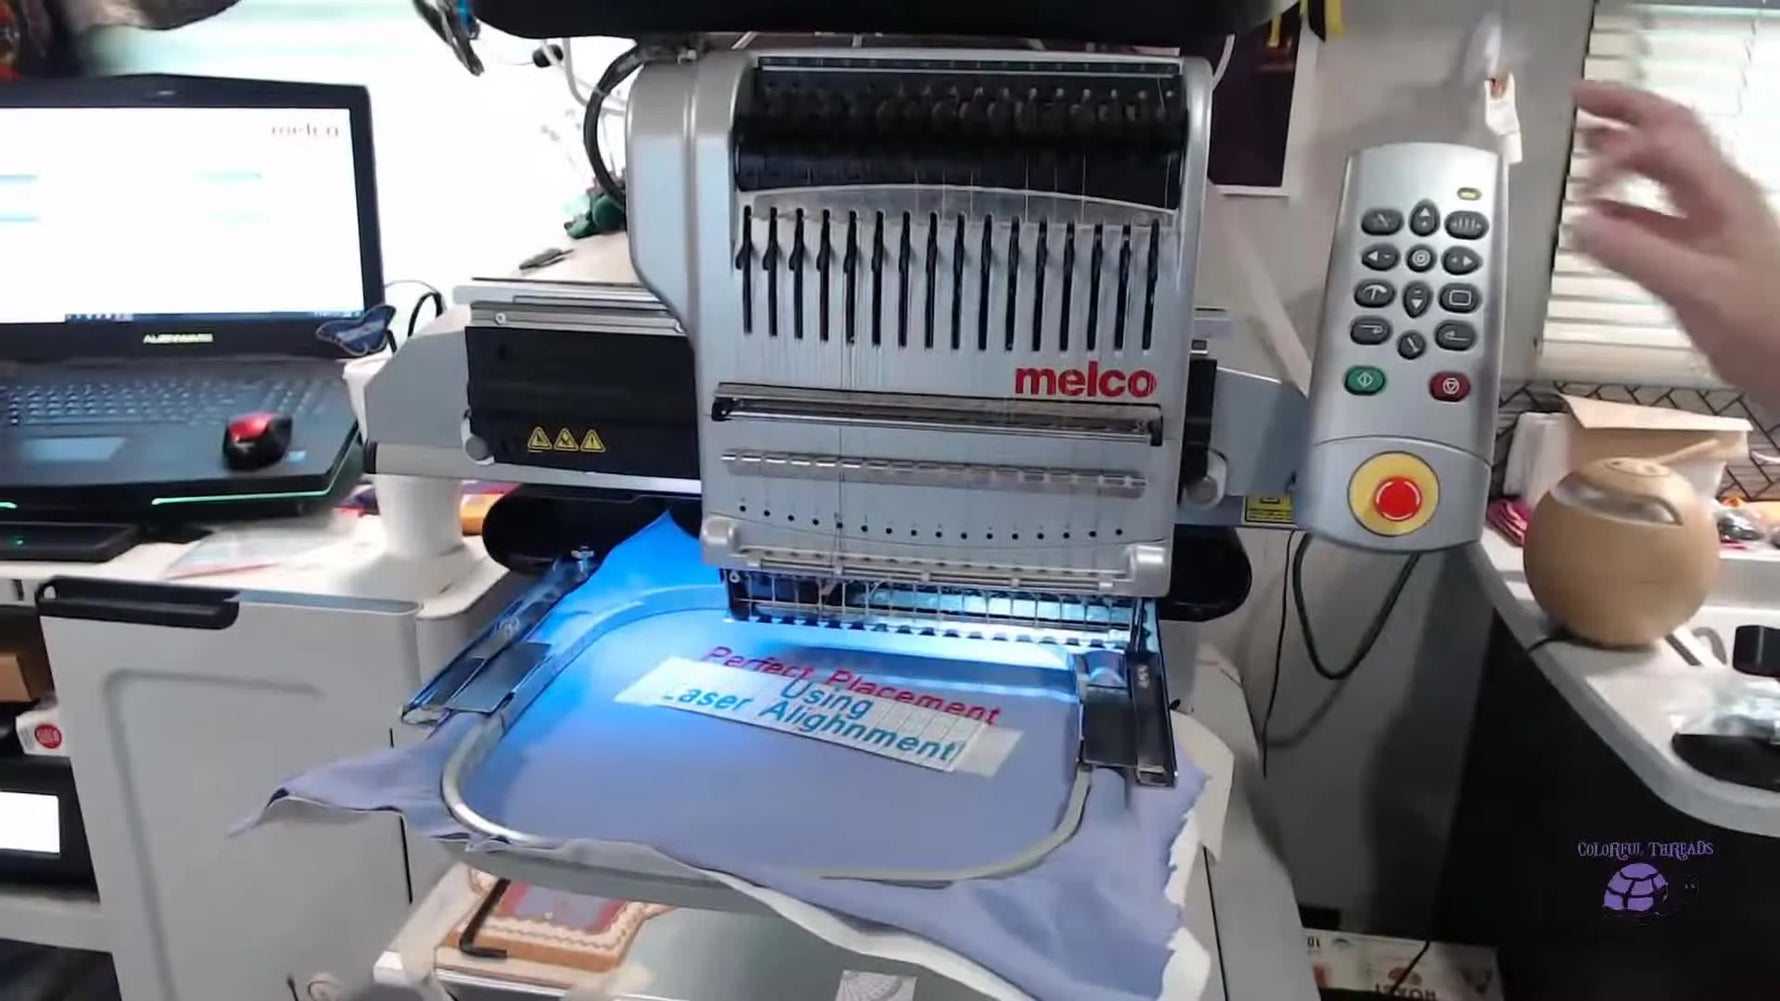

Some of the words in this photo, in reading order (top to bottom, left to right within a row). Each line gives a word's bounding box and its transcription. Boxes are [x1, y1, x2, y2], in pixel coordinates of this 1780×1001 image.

[1015, 360, 1157, 398] melco
[702, 646, 815, 679] Perfect
[826, 670, 1000, 725] Placement
[780, 676, 874, 720] Using
[758, 700, 955, 762] Alighnment
